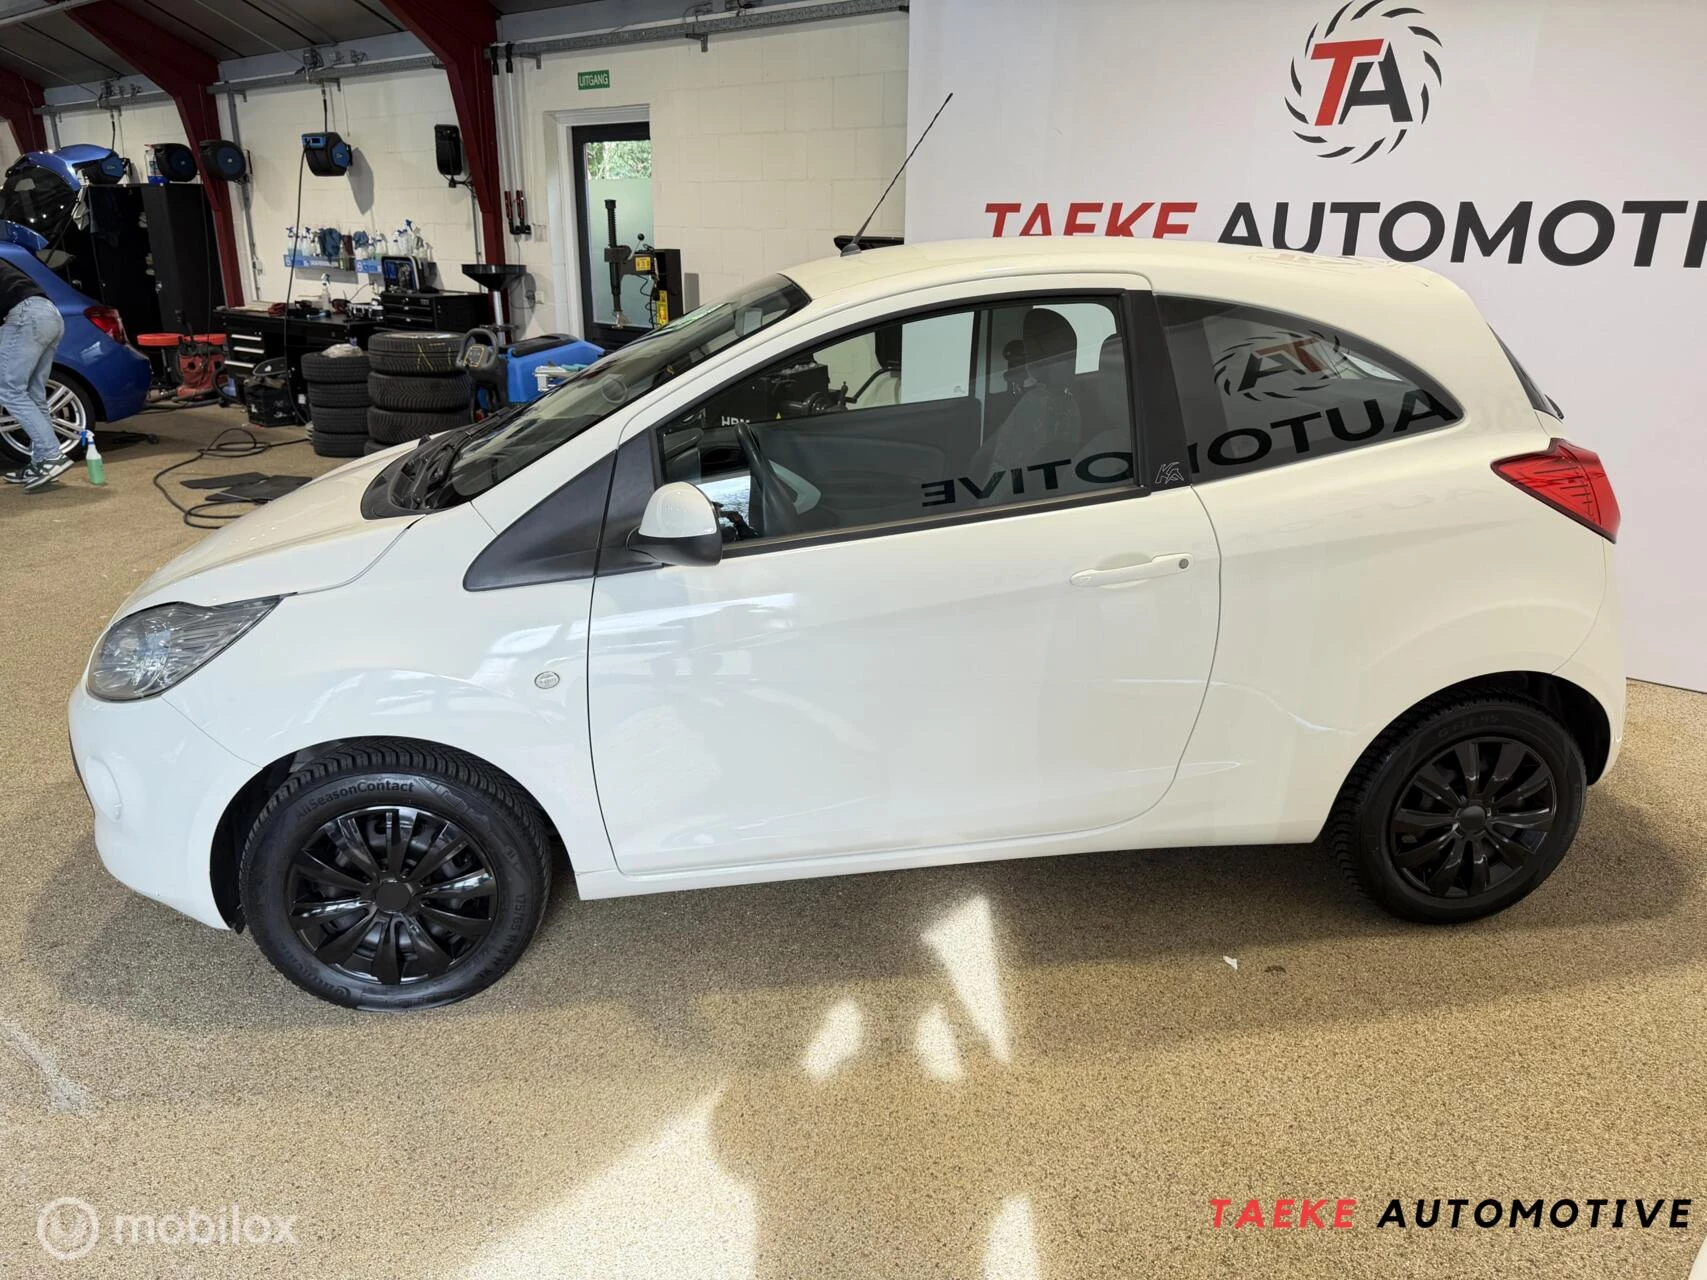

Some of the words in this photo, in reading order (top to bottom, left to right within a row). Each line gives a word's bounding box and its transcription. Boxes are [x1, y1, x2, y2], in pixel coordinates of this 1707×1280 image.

[578, 73, 609, 87] UITGANG
[1311, 38, 1413, 126] TA
[297, 780, 415, 817] AllSeasonContact
